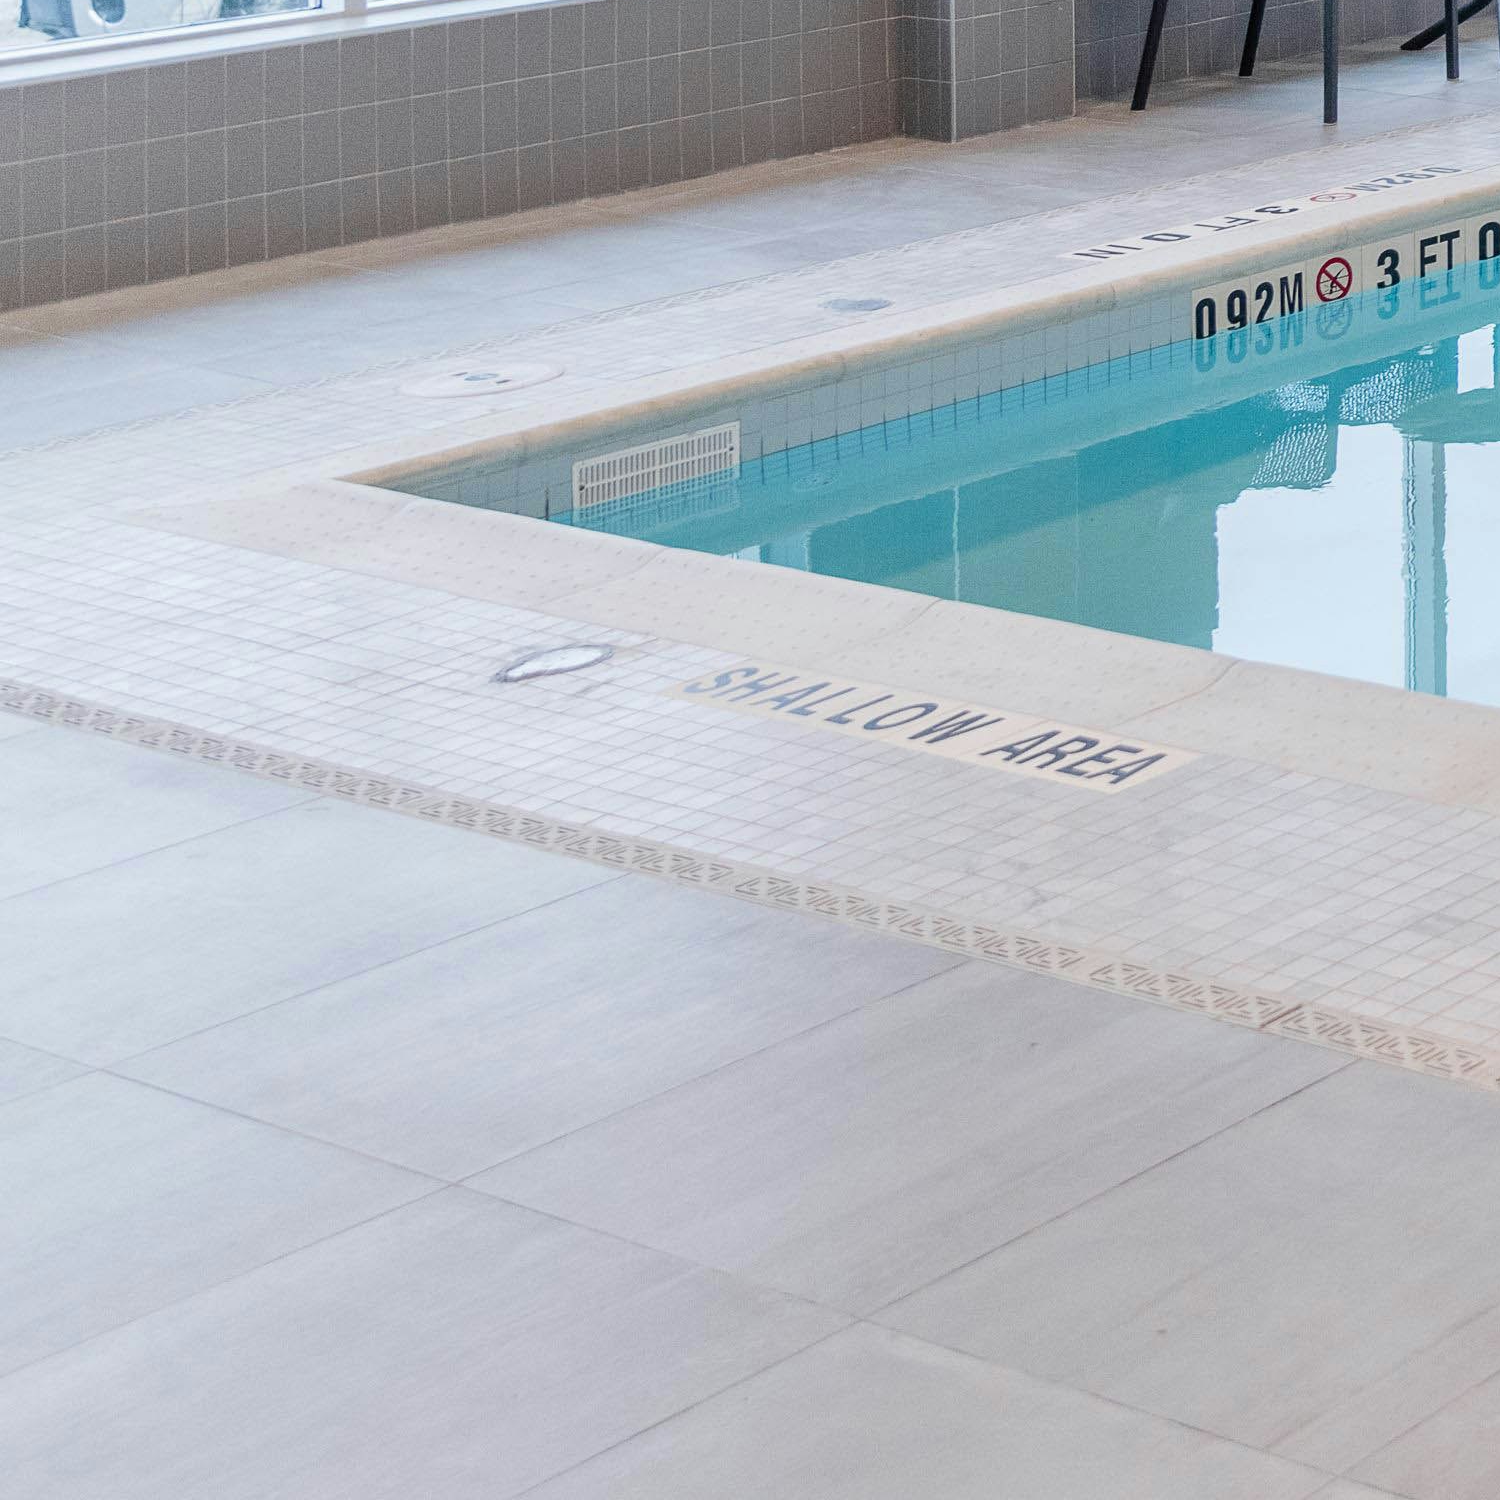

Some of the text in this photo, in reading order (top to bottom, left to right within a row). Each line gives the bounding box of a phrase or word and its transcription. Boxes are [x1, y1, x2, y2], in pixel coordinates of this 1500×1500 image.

[1194, 215, 1257, 232] FT
[1255, 204, 1299, 215] 3
[1376, 248, 1400, 289] 3
[1420, 230, 1461, 278] FT
[682, 666, 1169, 788] SHALLOW AREA
